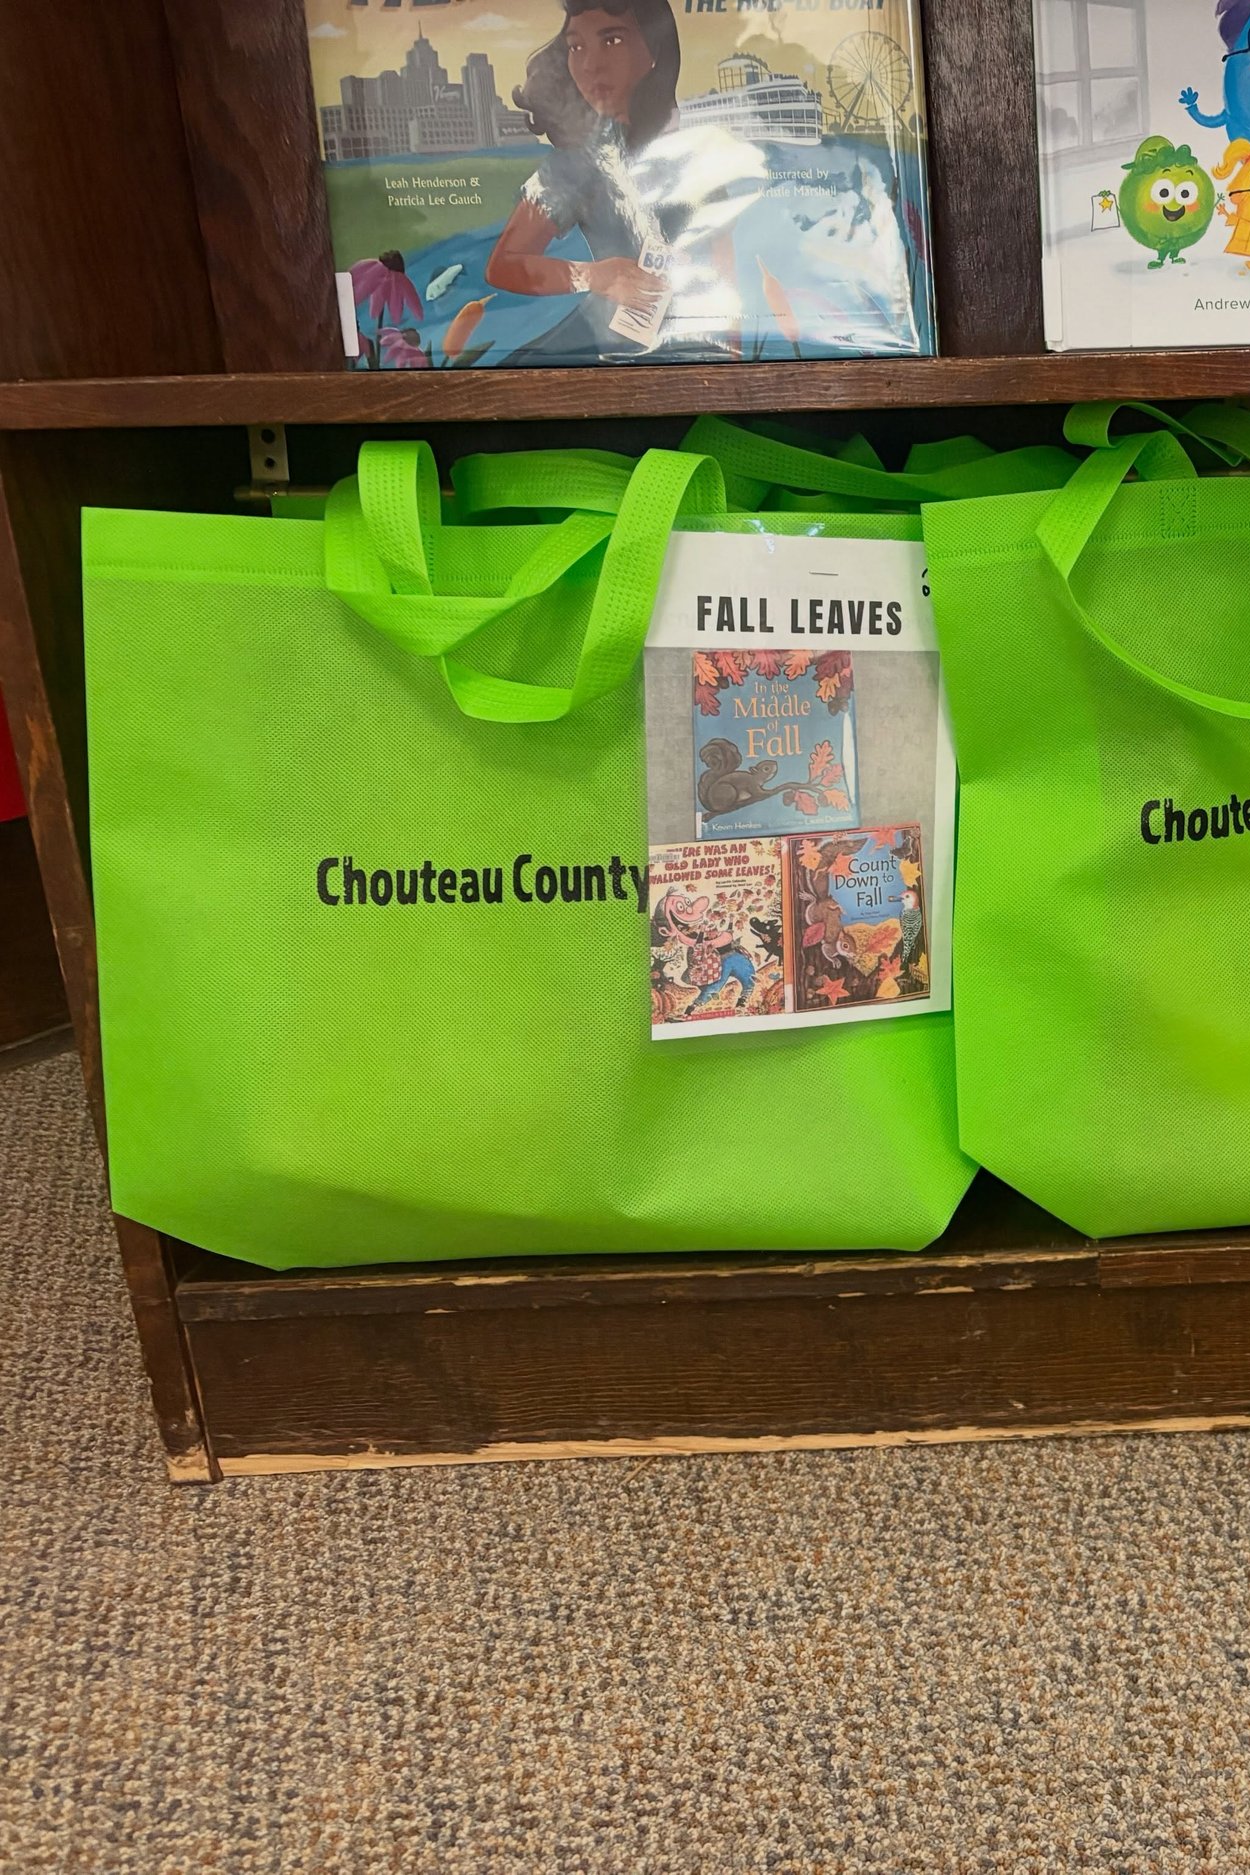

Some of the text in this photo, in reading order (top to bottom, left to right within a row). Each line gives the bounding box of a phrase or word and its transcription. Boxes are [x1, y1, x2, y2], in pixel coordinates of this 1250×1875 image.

[816, 168, 829, 181] by
[384, 177, 481, 189] Leah Henderson &
[793, 184, 837, 198] Marshall
[388, 193, 482, 207] Patricia Lee Gauch
[1194, 298, 1250, 311] Andrew
[697, 595, 902, 636] FALL LEAVES
[771, 681, 790, 694] the
[733, 694, 811, 718] Middle
[767, 719, 779, 733] of
[746, 724, 803, 758] Fall
[704, 843, 728, 856] WAS
[730, 843, 748, 854] AN
[665, 855, 750, 872] OLD LADY WHO
[848, 856, 897, 874] Count
[704, 867, 733, 880] SOME
[736, 864, 775, 877] LEAVES!
[316, 854, 649, 914] Chouteau County
[835, 873, 895, 890] Down to
[857, 887, 882, 908] Fall
